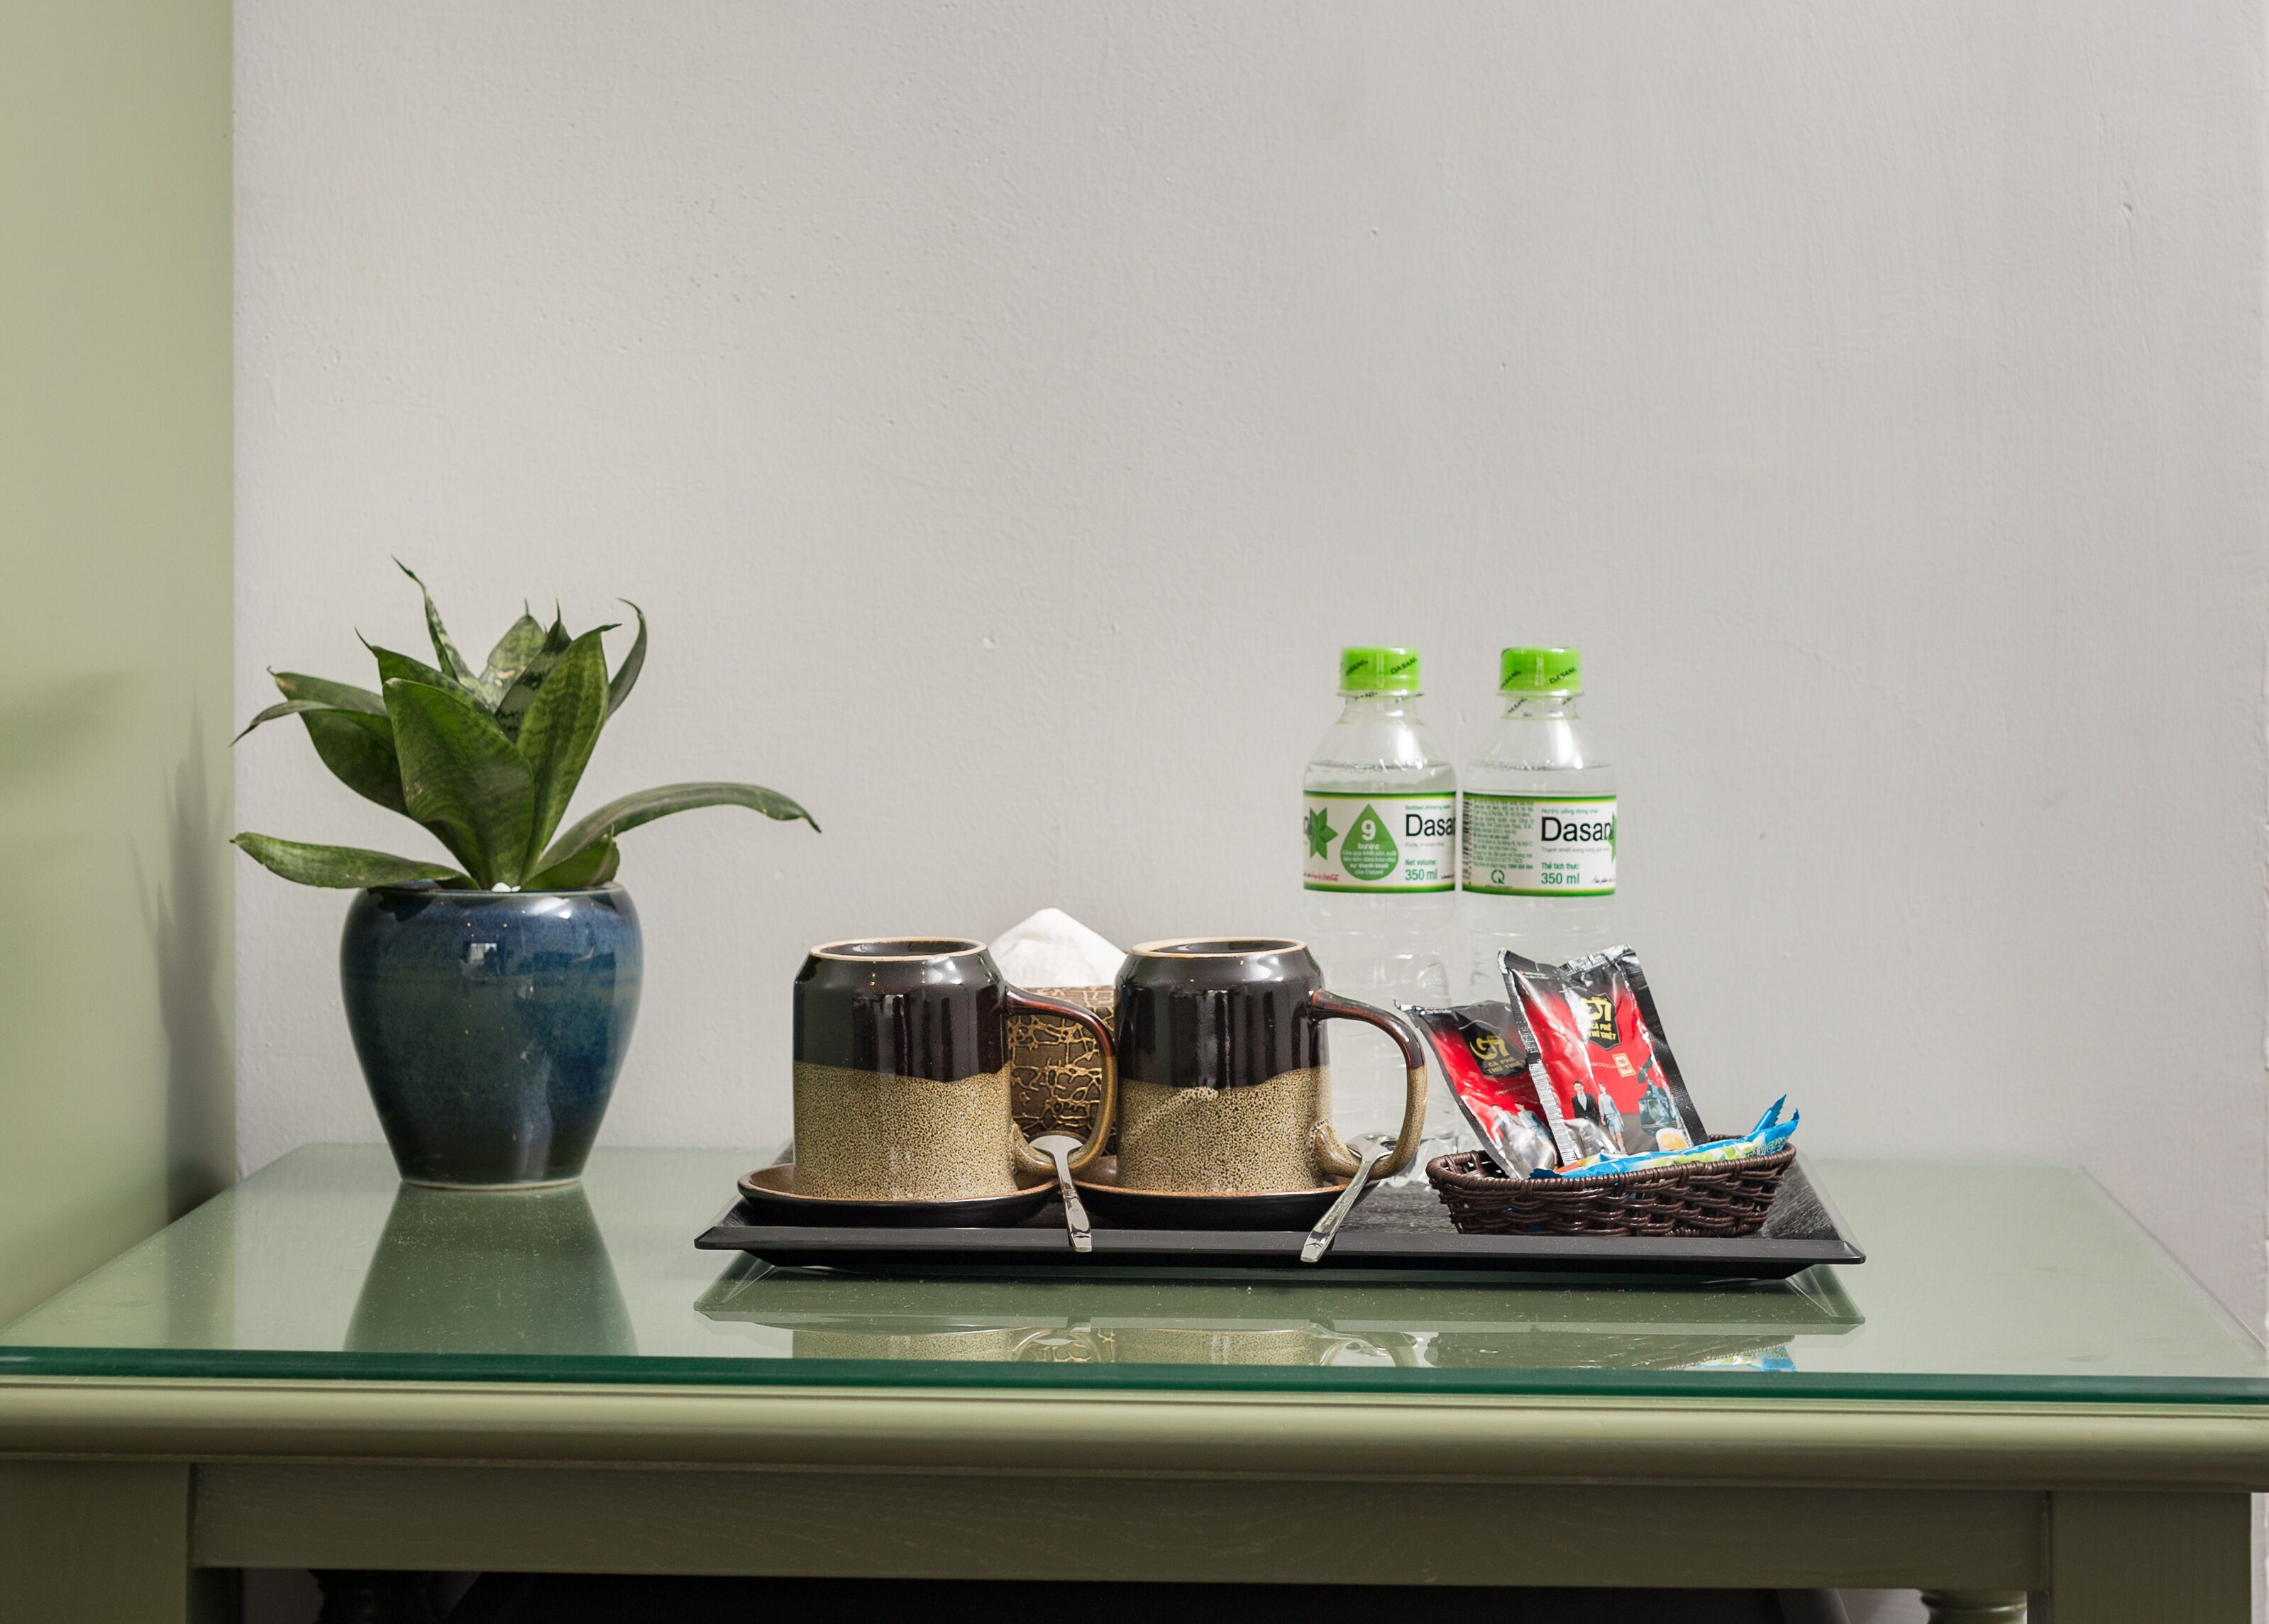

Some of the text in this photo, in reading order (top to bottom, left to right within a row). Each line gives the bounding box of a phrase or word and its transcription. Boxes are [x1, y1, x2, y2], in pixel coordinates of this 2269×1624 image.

[1361, 819, 1376, 841] 9
[1405, 868, 1437, 880] 350 ml
[1540, 872, 1580, 884] 350 ml
